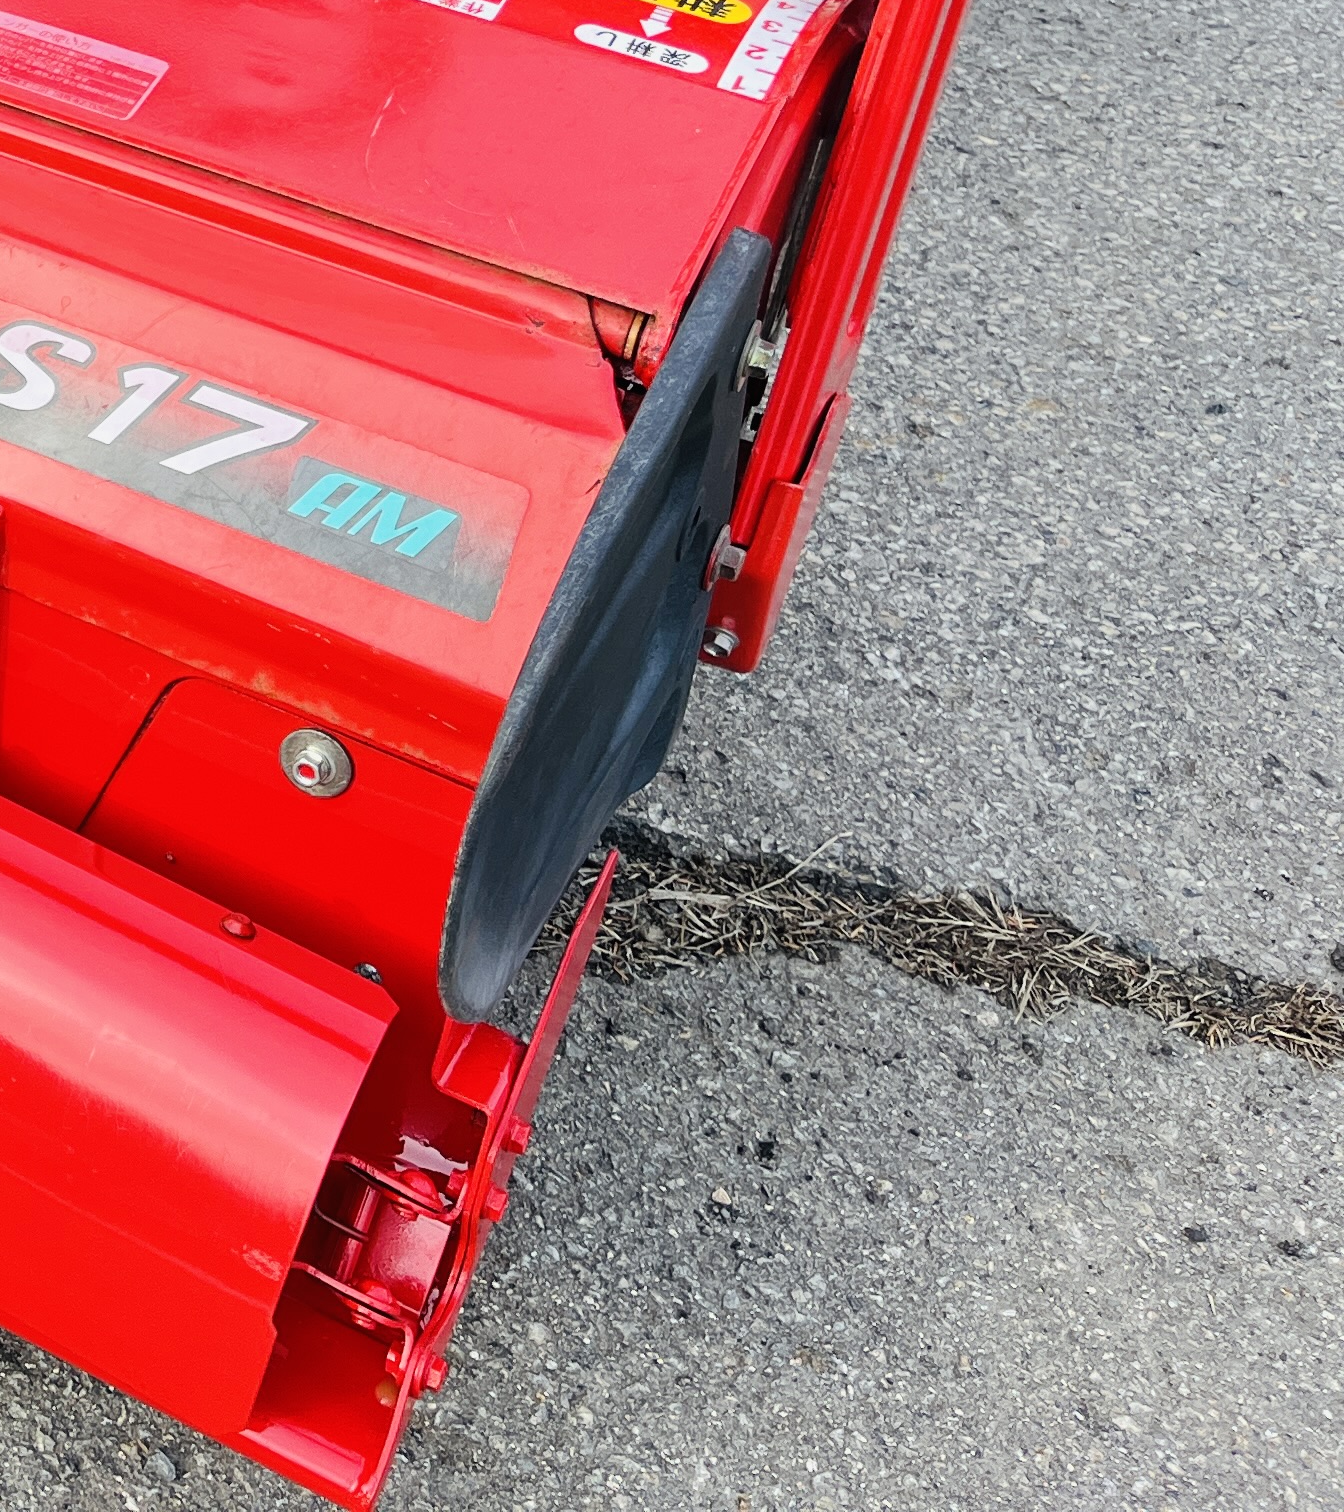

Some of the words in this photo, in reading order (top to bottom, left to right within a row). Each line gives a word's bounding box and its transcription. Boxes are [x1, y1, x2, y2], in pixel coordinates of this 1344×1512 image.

[777, 1, 797, 11] 4
[763, 19, 783, 33] 3
[594, 30, 691, 68] 深耕し
[744, 44, 768, 61] 2
[731, 75, 746, 91] 1
[87, 362, 317, 476] 17
[286, 471, 460, 559] AM
